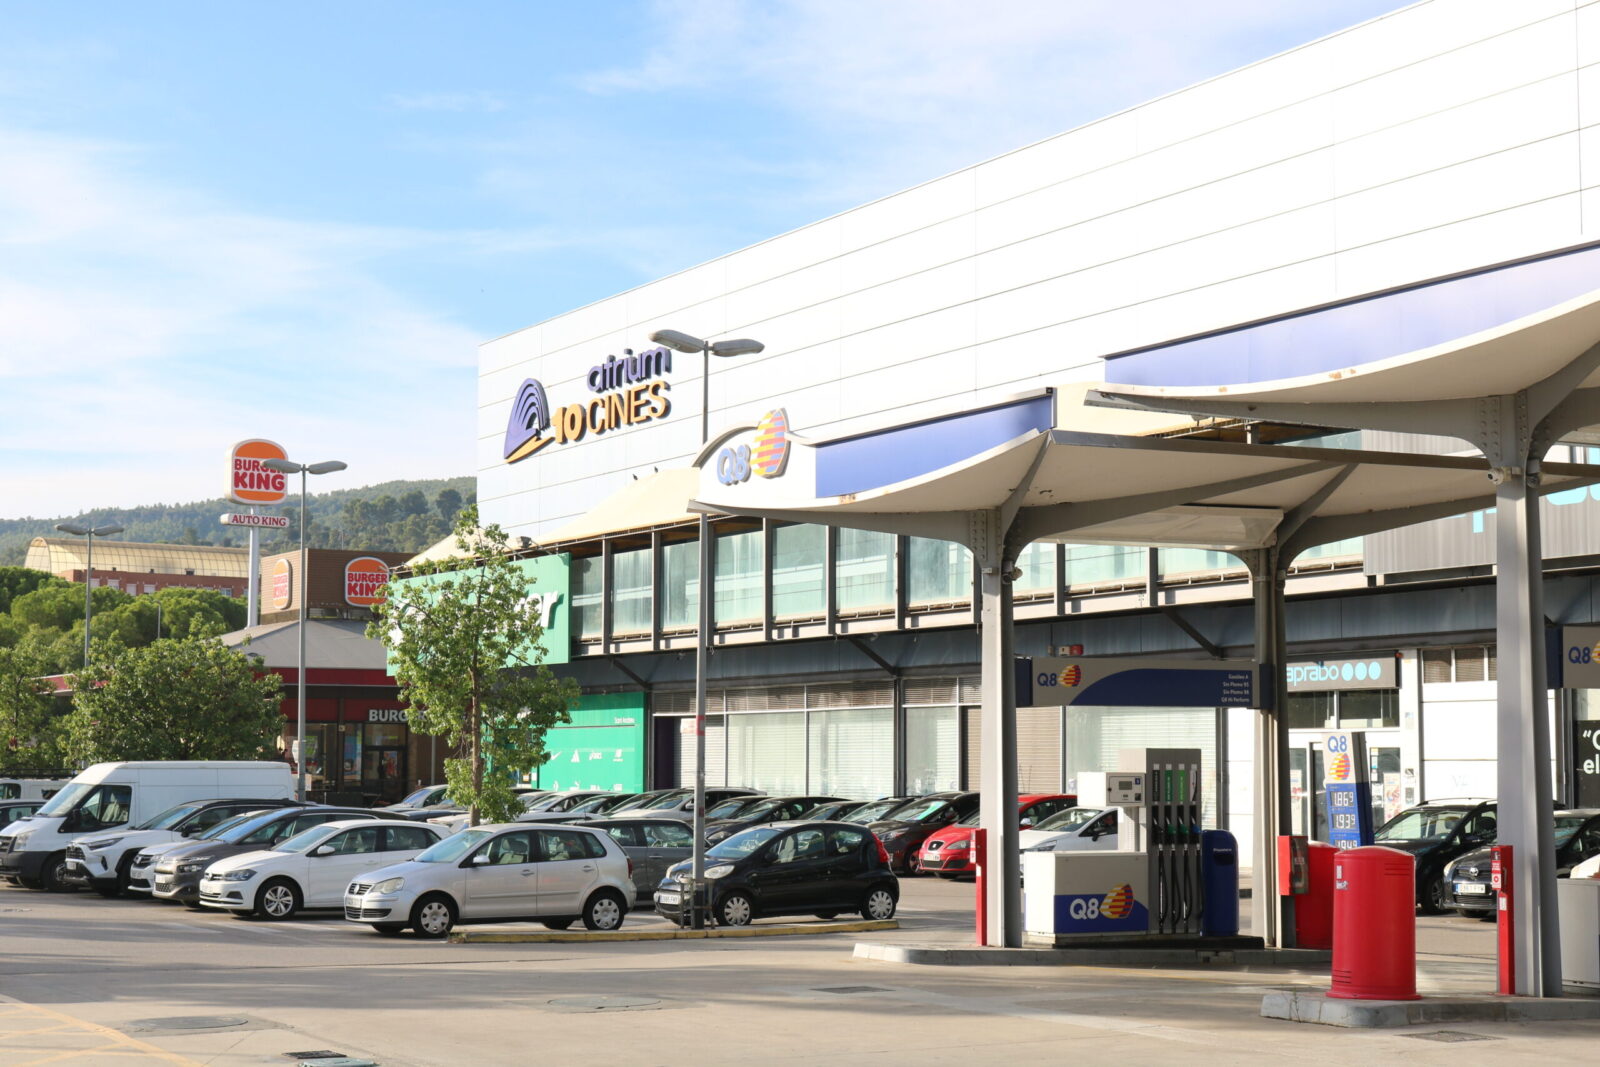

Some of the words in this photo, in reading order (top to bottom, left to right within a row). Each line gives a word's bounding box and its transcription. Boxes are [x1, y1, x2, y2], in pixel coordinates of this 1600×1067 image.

[587, 346, 672, 391] atrium
[552, 403, 585, 444] 10
[586, 380, 671, 434] CINES
[717, 444, 751, 485] Q8
[234, 471, 285, 491] KING
[232, 514, 260, 525] AUTO
[261, 516, 286, 527] KING
[347, 572, 388, 583] BURGER
[1568, 646, 1591, 664] Q8
[1037, 672, 1058, 687] Q8
[1328, 735, 1347, 753] Q8
[1070, 899, 1099, 920] Q8
